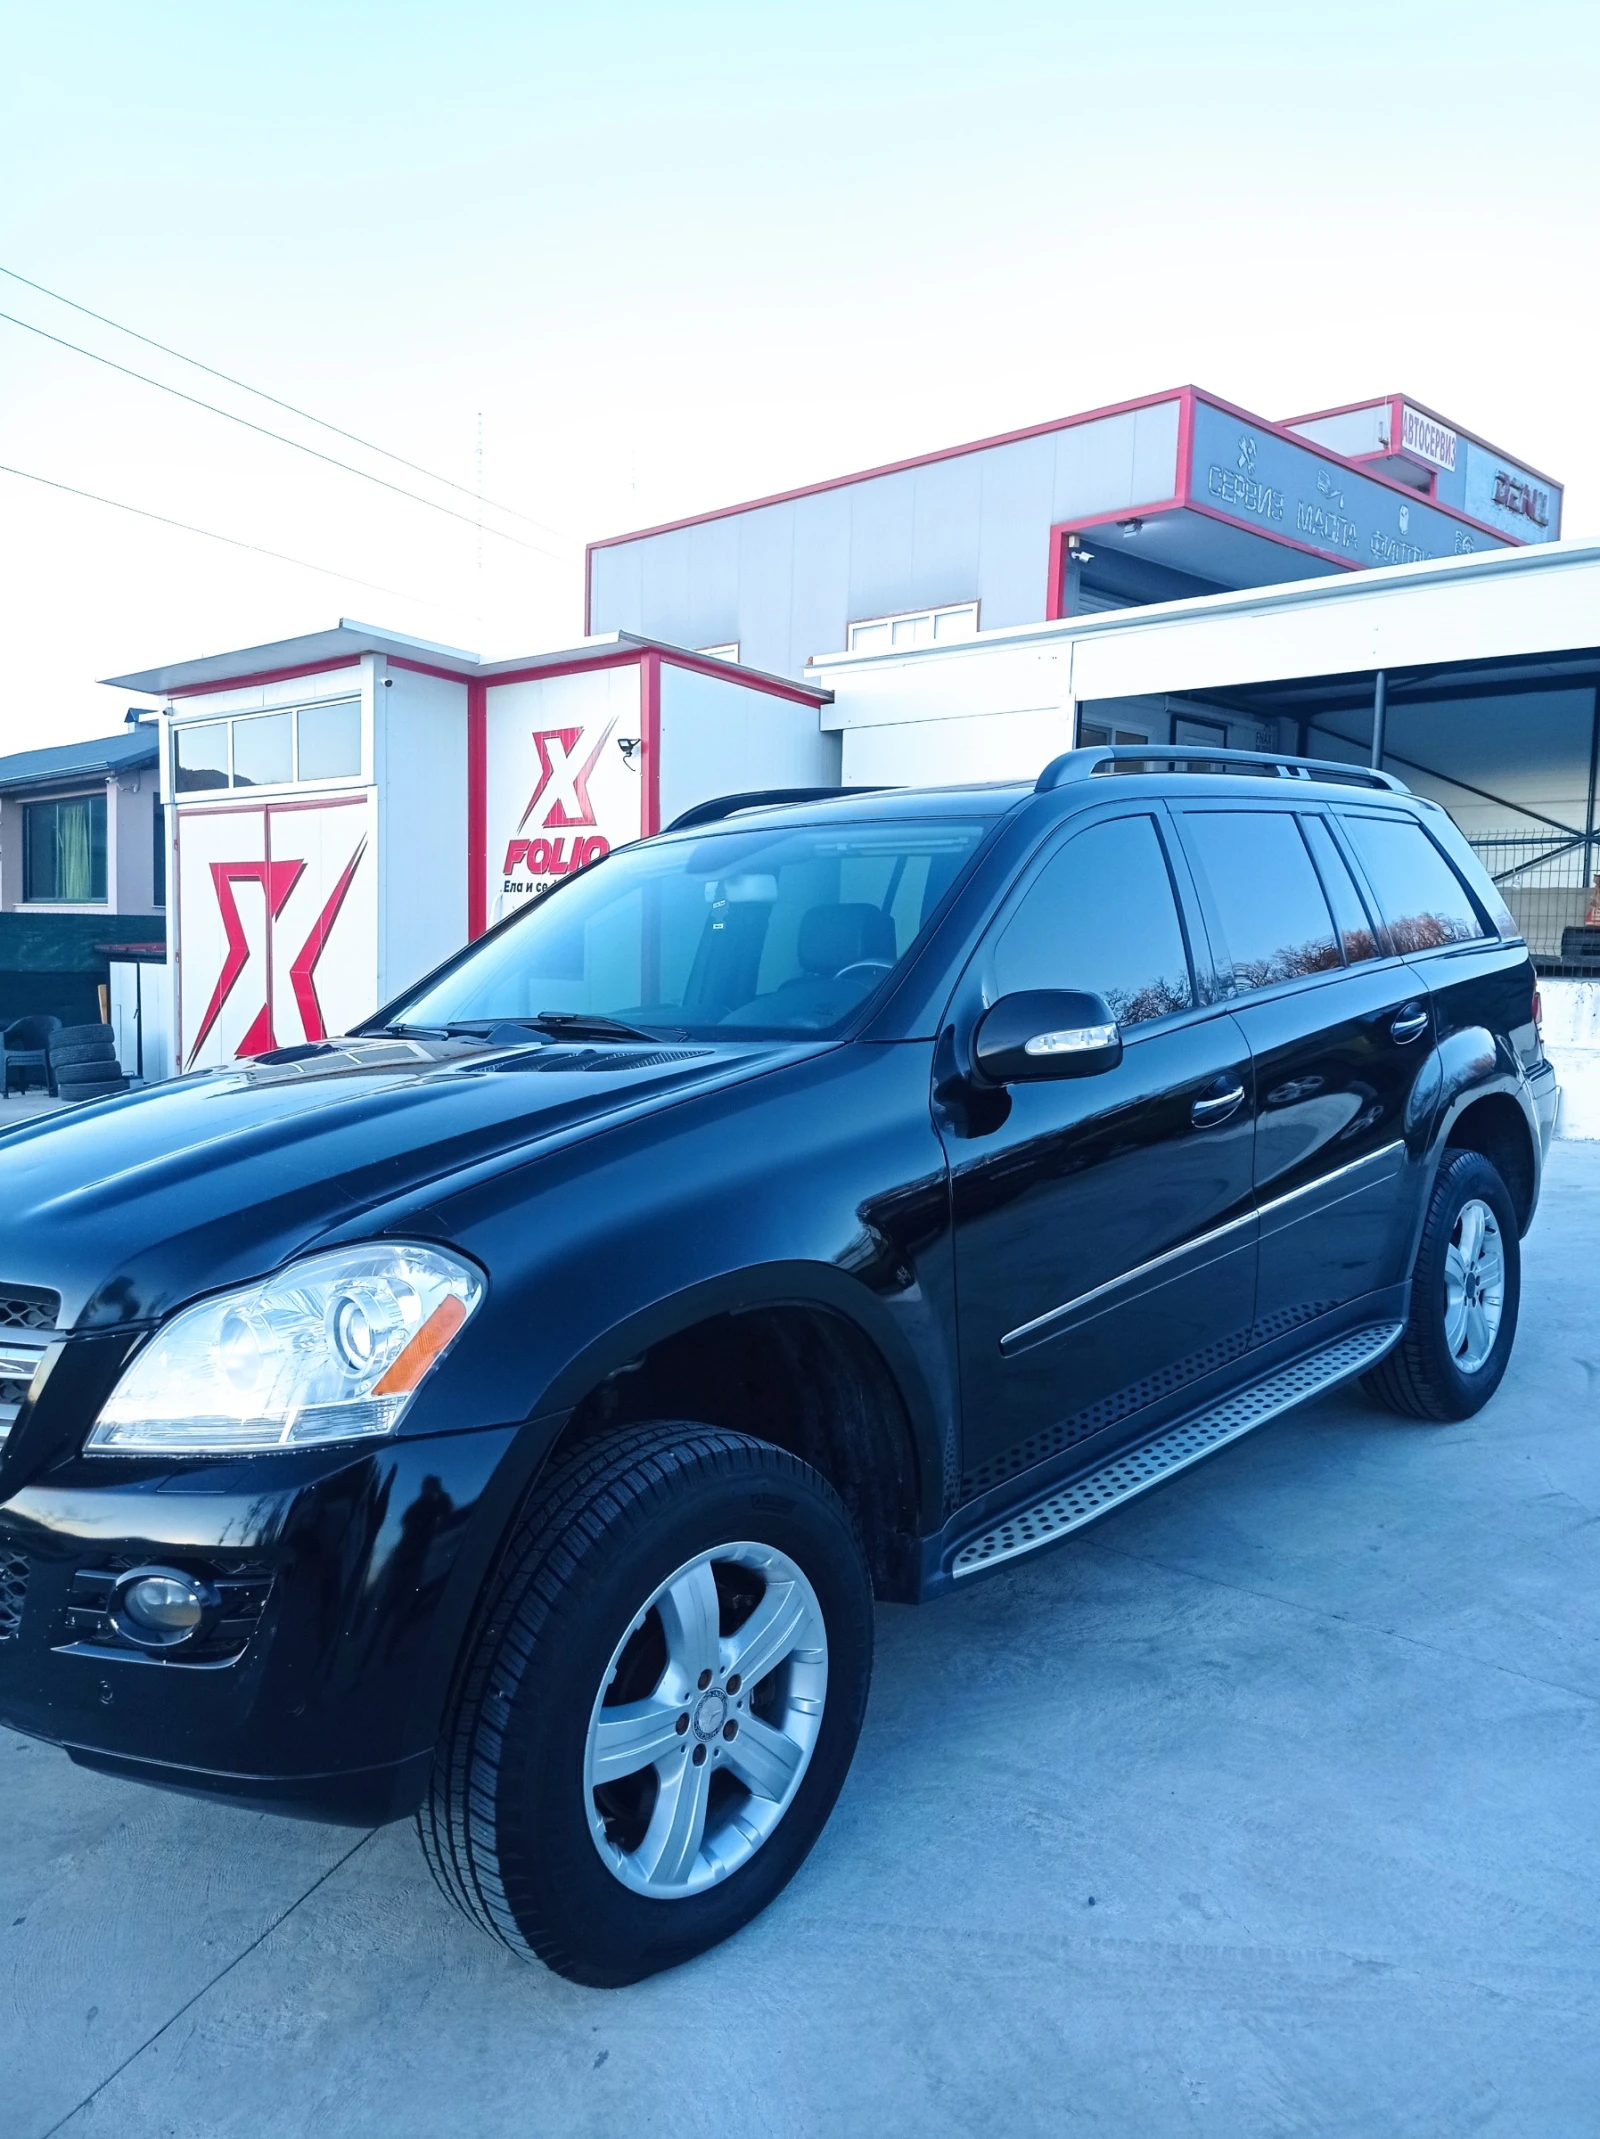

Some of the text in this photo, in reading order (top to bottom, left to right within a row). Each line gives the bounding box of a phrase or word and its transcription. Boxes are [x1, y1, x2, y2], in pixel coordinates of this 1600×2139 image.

[1402, 411, 1456, 467] АВТОСЕРВИЗ
[1208, 464, 1284, 521] СЕРВИЗ
[1296, 500, 1358, 550] МАСЛА
[503, 836, 610, 875] FOLIO
[503, 880, 523, 893] Ела
[525, 882, 533, 893] и
